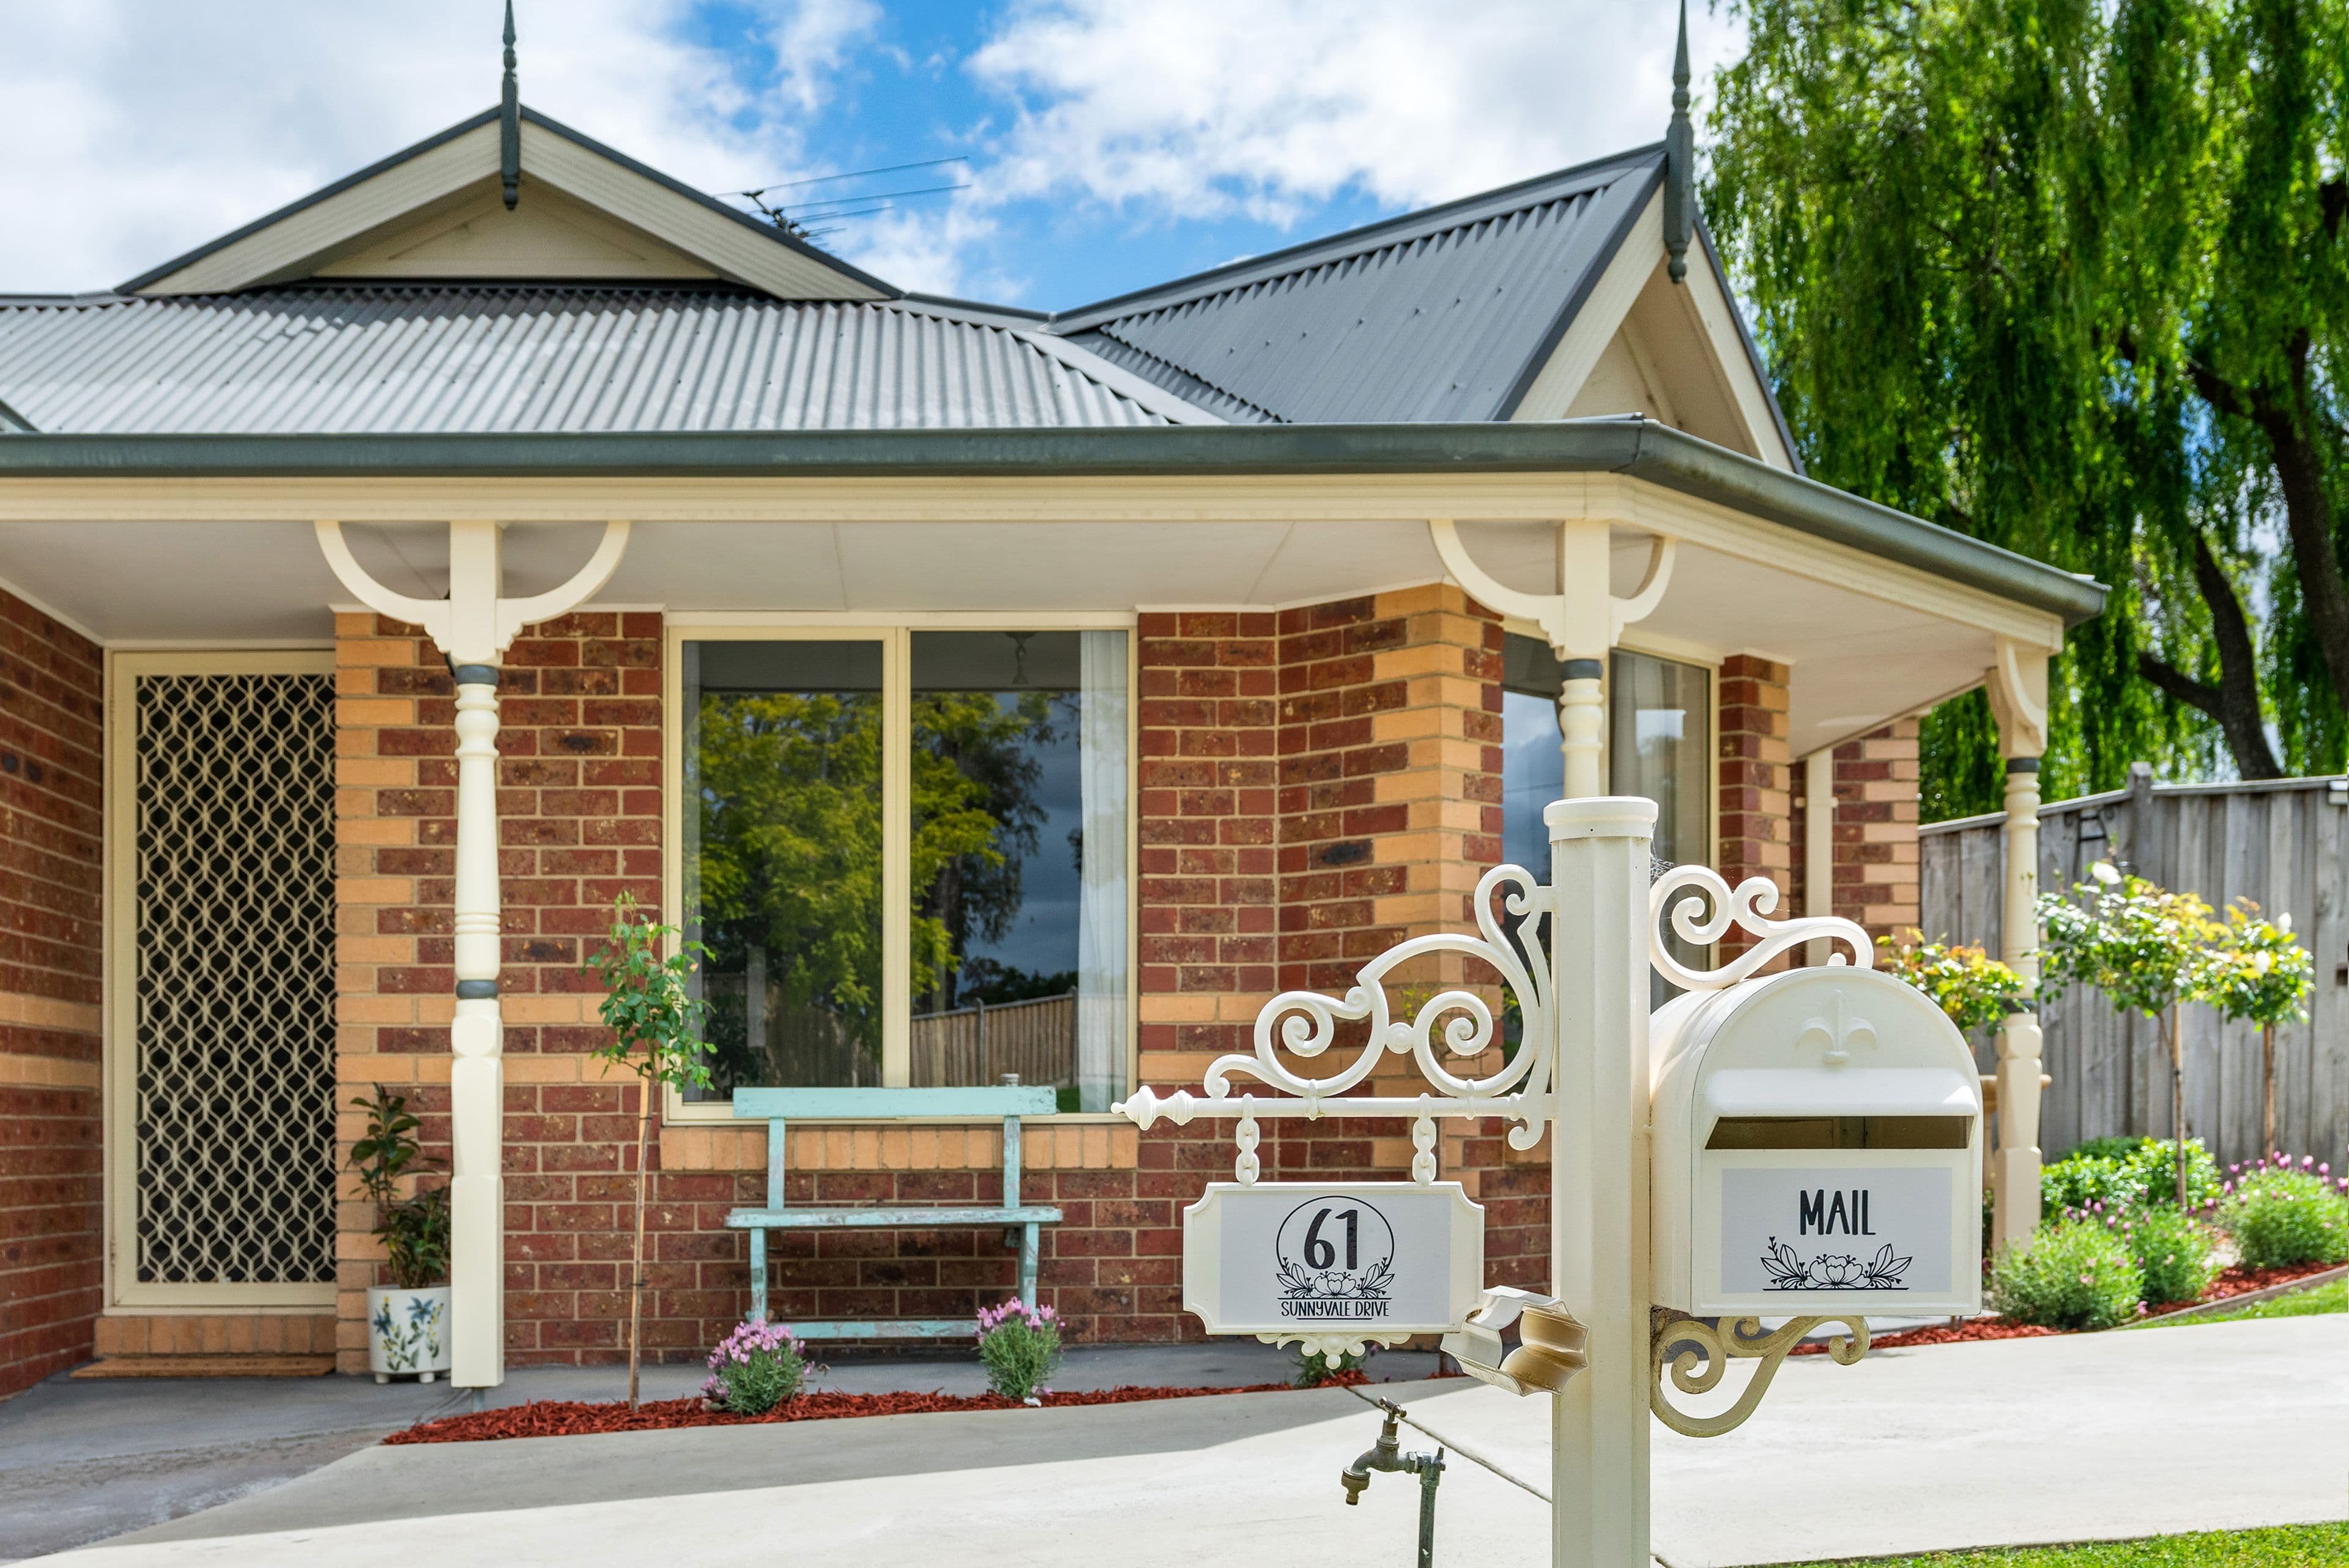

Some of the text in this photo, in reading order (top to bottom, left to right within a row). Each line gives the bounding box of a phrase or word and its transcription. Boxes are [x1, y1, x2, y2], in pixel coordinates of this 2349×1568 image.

[1800, 1189, 1876, 1236] MAIL
[1304, 1208, 1358, 1270] 61
[1281, 1301, 1389, 1317] SUNNYVALE DRIVE
